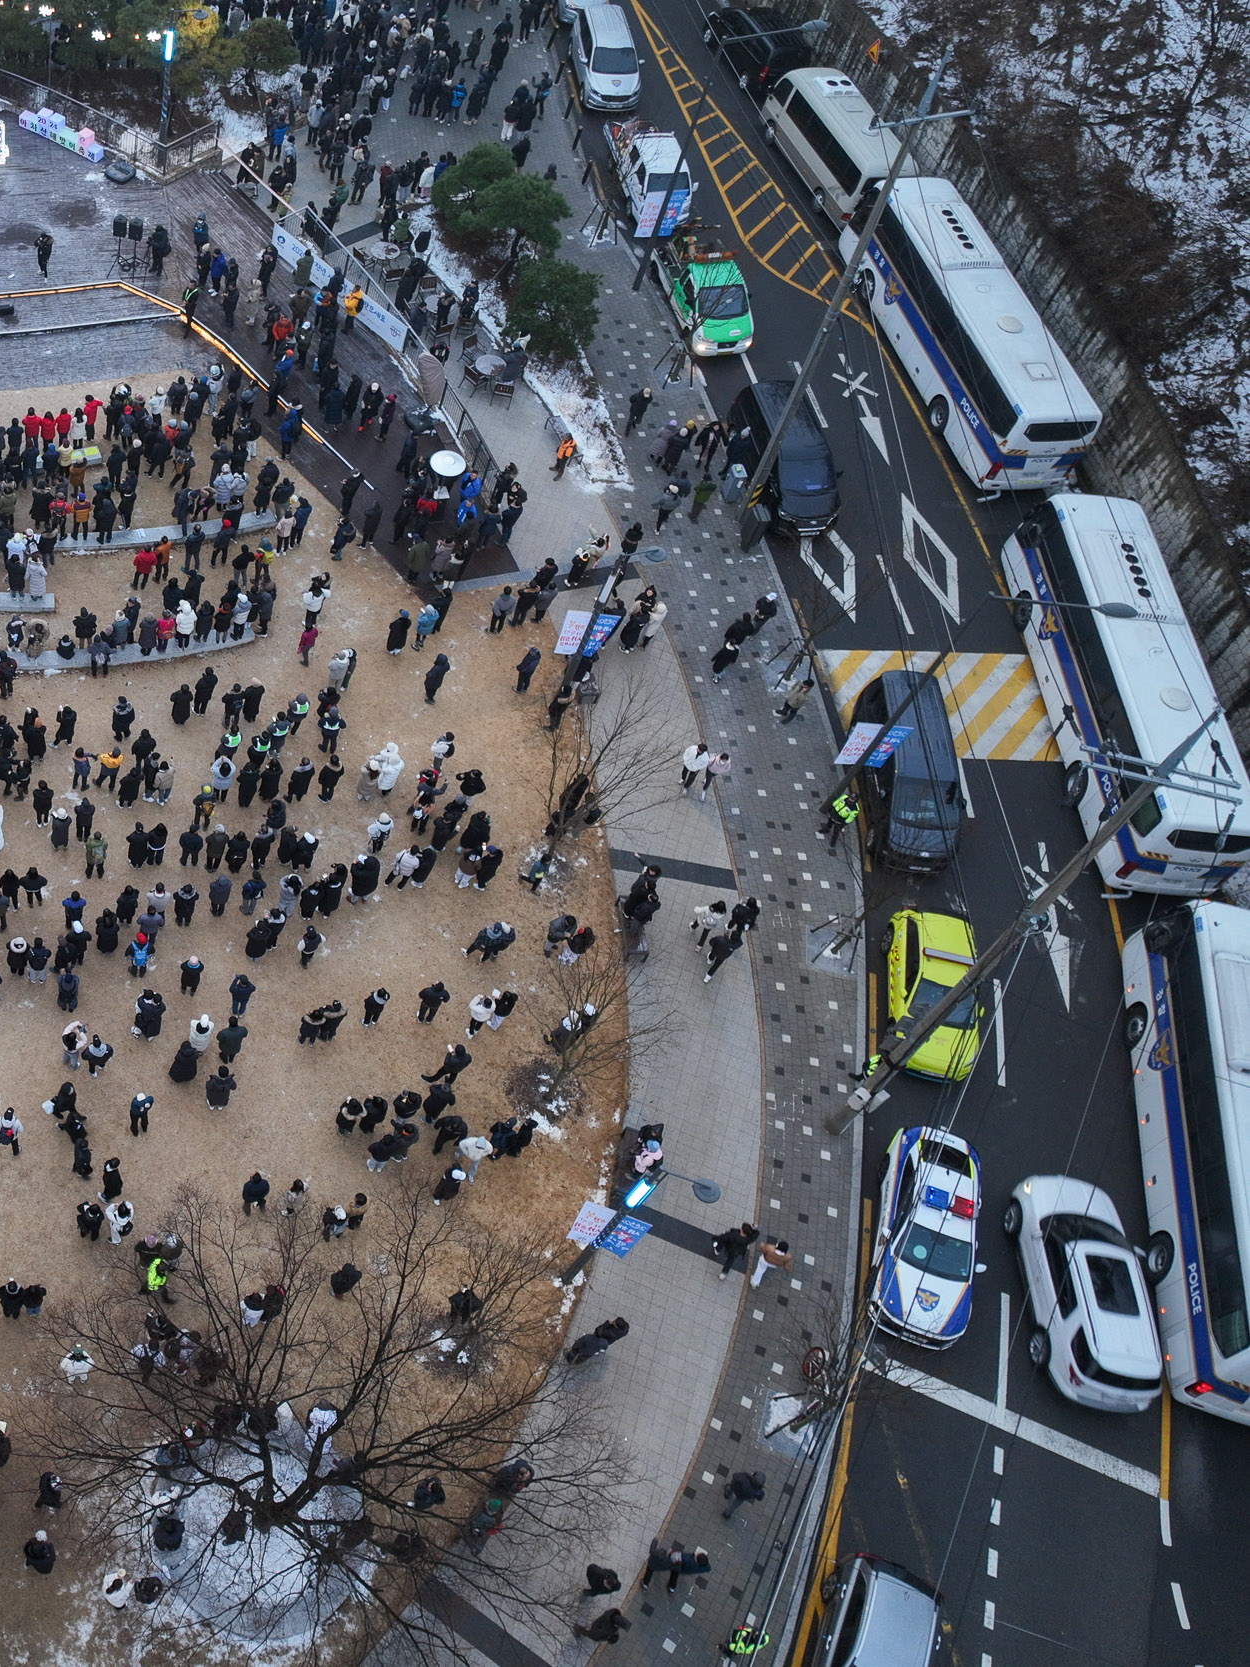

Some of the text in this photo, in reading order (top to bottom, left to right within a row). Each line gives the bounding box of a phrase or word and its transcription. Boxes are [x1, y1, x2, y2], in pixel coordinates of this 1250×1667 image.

[291, 243, 306, 258] 202
[959, 397, 980, 429] POLICE
[1173, 865, 1203, 873] POLICE
[1187, 1261, 1203, 1316] POLICE
